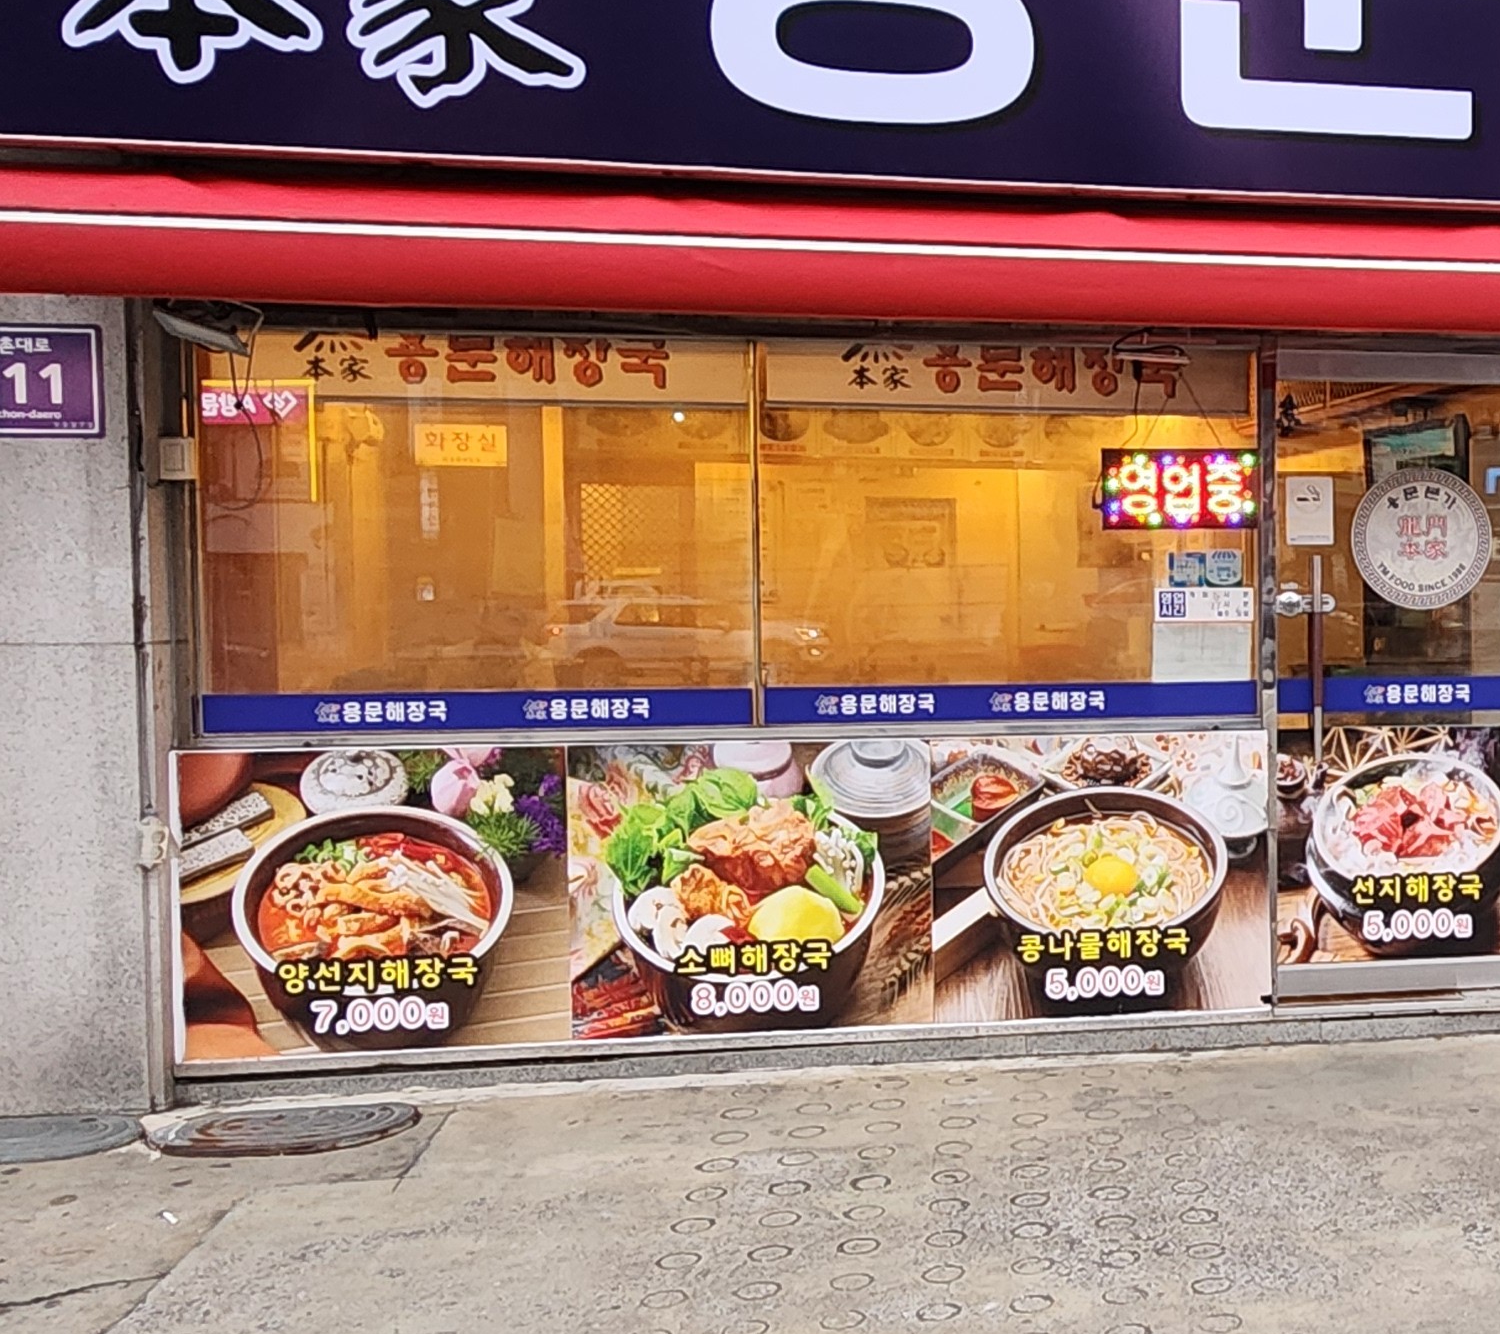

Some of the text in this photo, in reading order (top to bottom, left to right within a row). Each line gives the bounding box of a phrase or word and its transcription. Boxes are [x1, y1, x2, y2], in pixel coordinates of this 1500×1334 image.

[425, 431, 498, 453] 화장실
[1118, 460, 1243, 516] 영업중
[1388, 573, 1415, 592] FOOD
[1418, 578, 1448, 593] SINCE
[1161, 592, 1185, 604] 영업
[1161, 604, 1185, 617] 시간
[840, 693, 936, 715] 용문해장국
[1013, 691, 1106, 712] 용문해장국
[1386, 684, 1471, 704] 용문해장국
[342, 701, 448, 723] 용문해장국
[549, 698, 651, 720] 용문해장국
[1351, 873, 1484, 905] 선지해장국
[1362, 907, 1473, 943] 5,000원
[676, 941, 833, 975] 소뼈해장국
[1016, 927, 1191, 964] 콩나물해장국
[278, 956, 479, 994] 양선지해장국
[1044, 964, 1166, 1002] 5,000원
[690, 978, 821, 1018] 8,000원
[309, 996, 450, 1036] 7,000원
